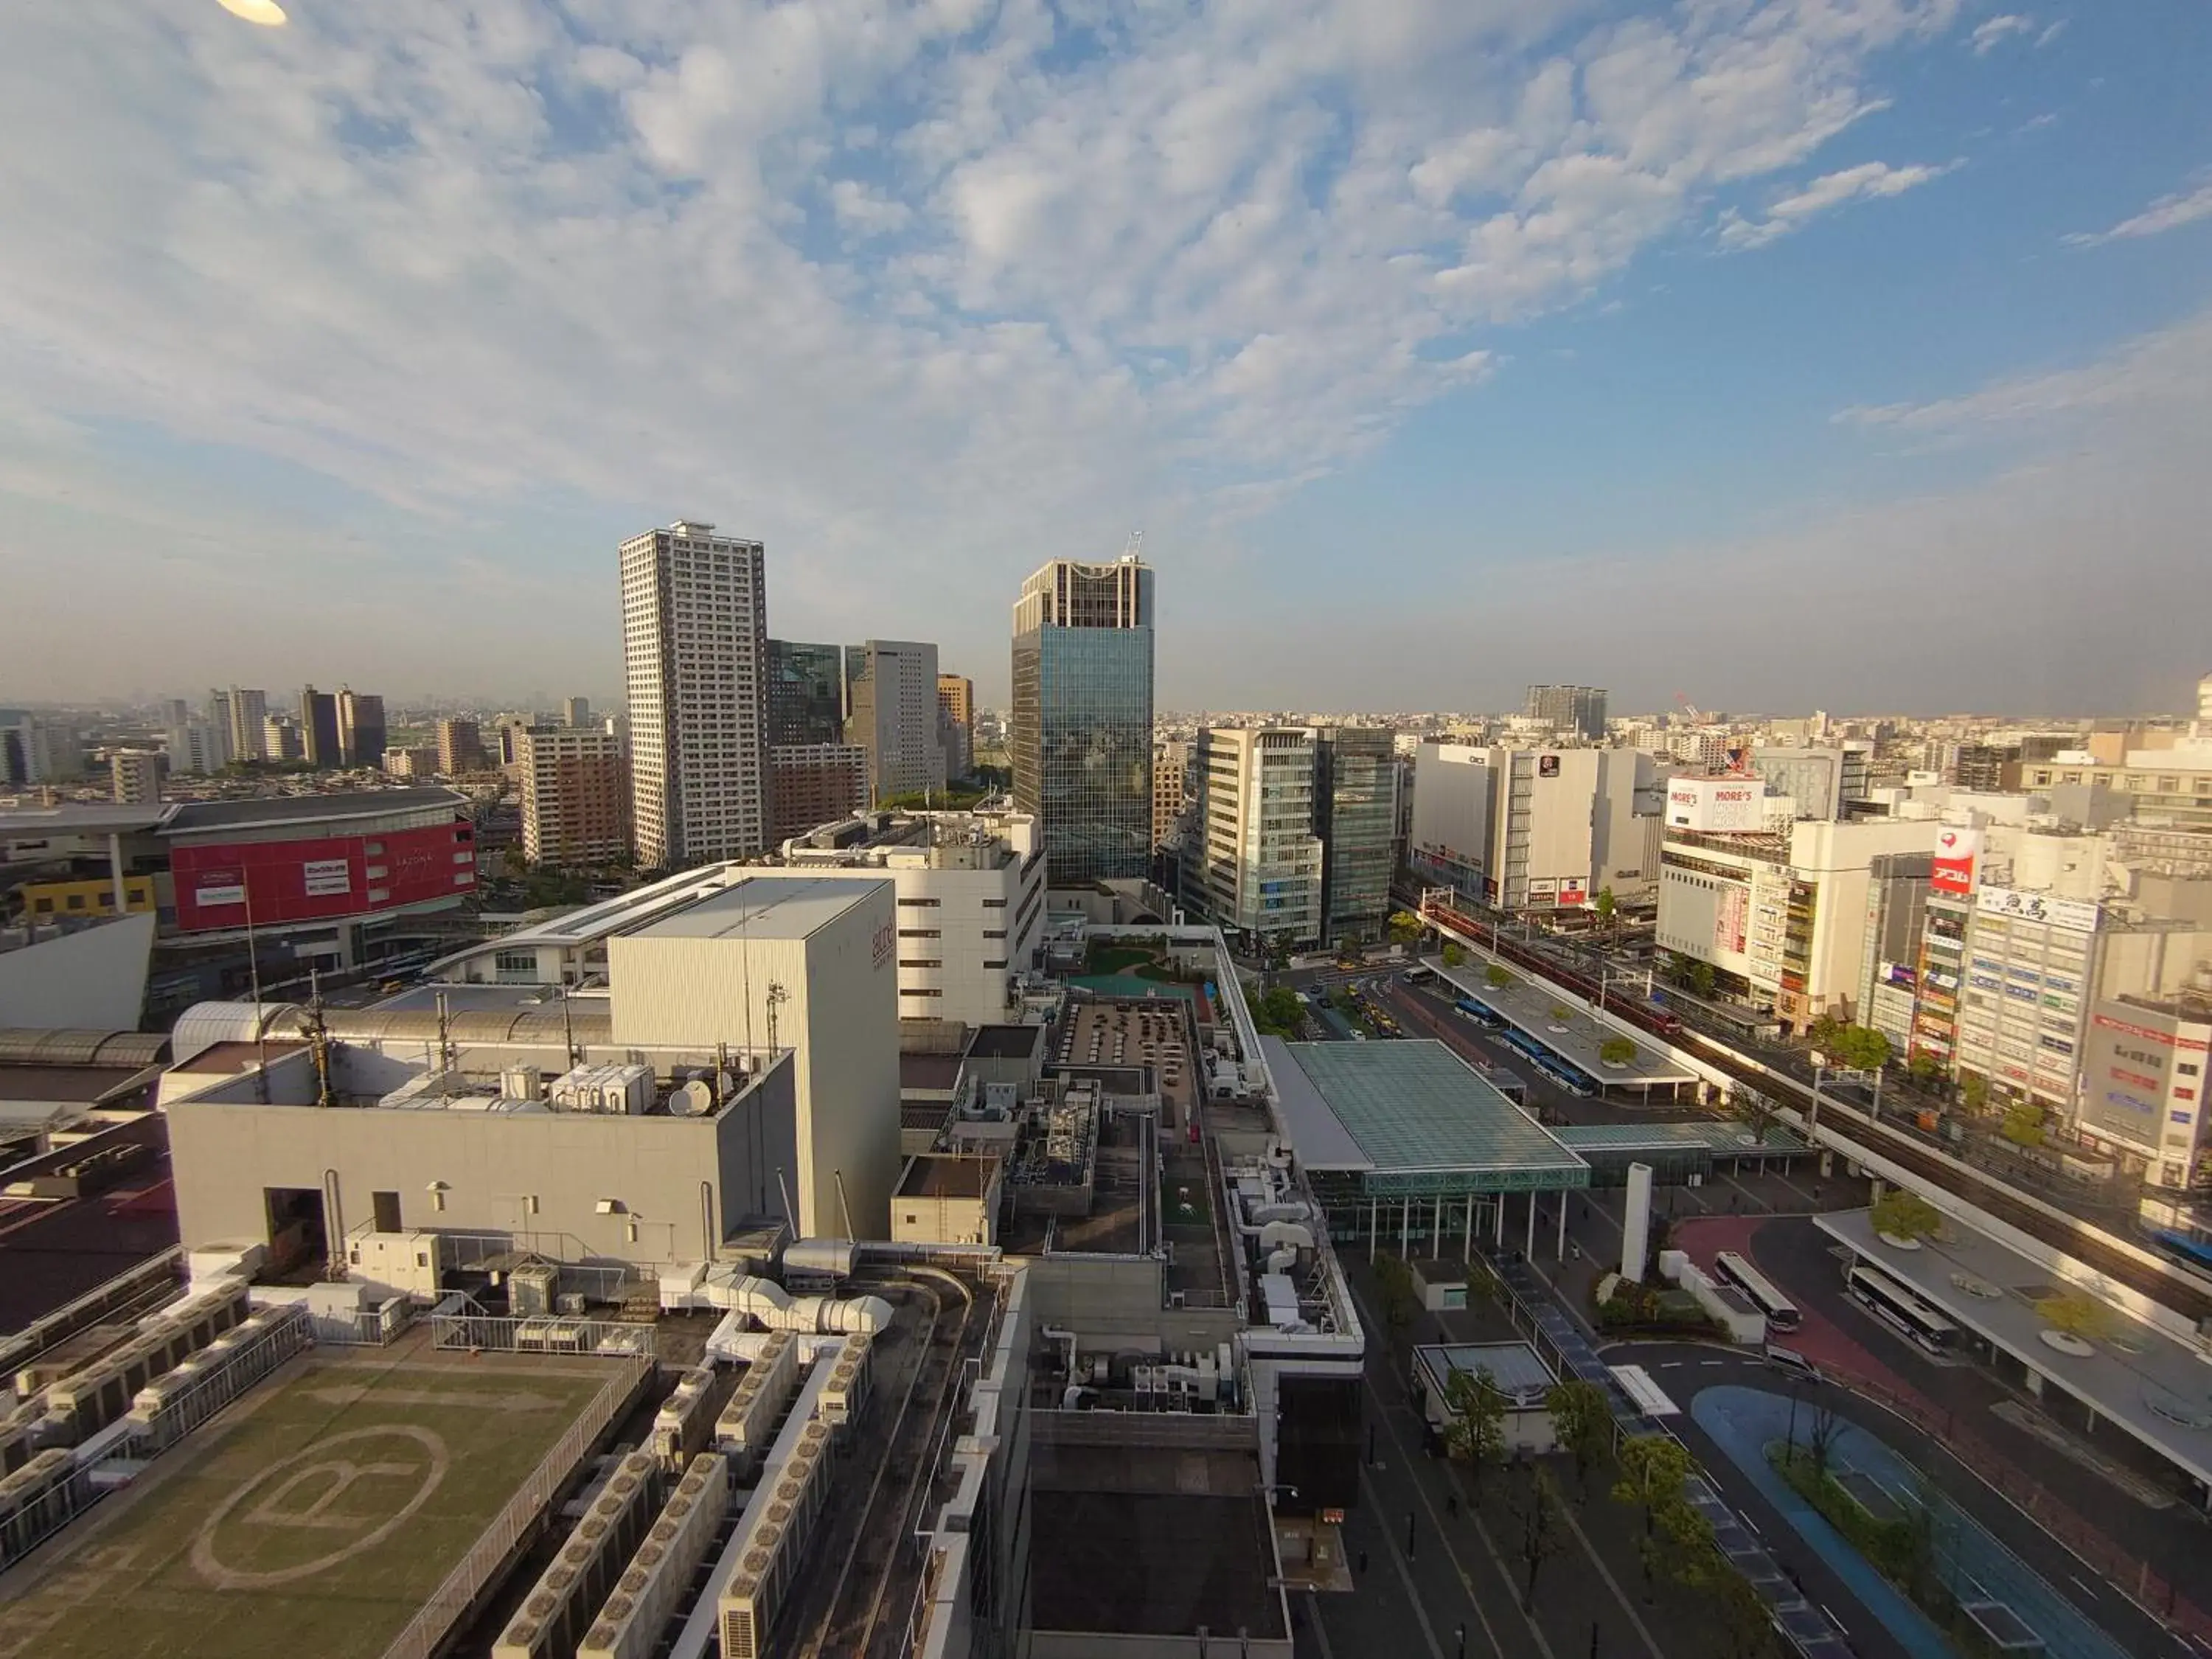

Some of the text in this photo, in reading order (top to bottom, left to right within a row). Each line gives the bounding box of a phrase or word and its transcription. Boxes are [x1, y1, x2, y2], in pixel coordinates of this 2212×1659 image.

[1671, 791, 1697, 804] MORE'S
[1714, 791, 1753, 801] MORE'S
[1934, 867, 1969, 883] アコム
[242, 1460, 420, 1529] R
